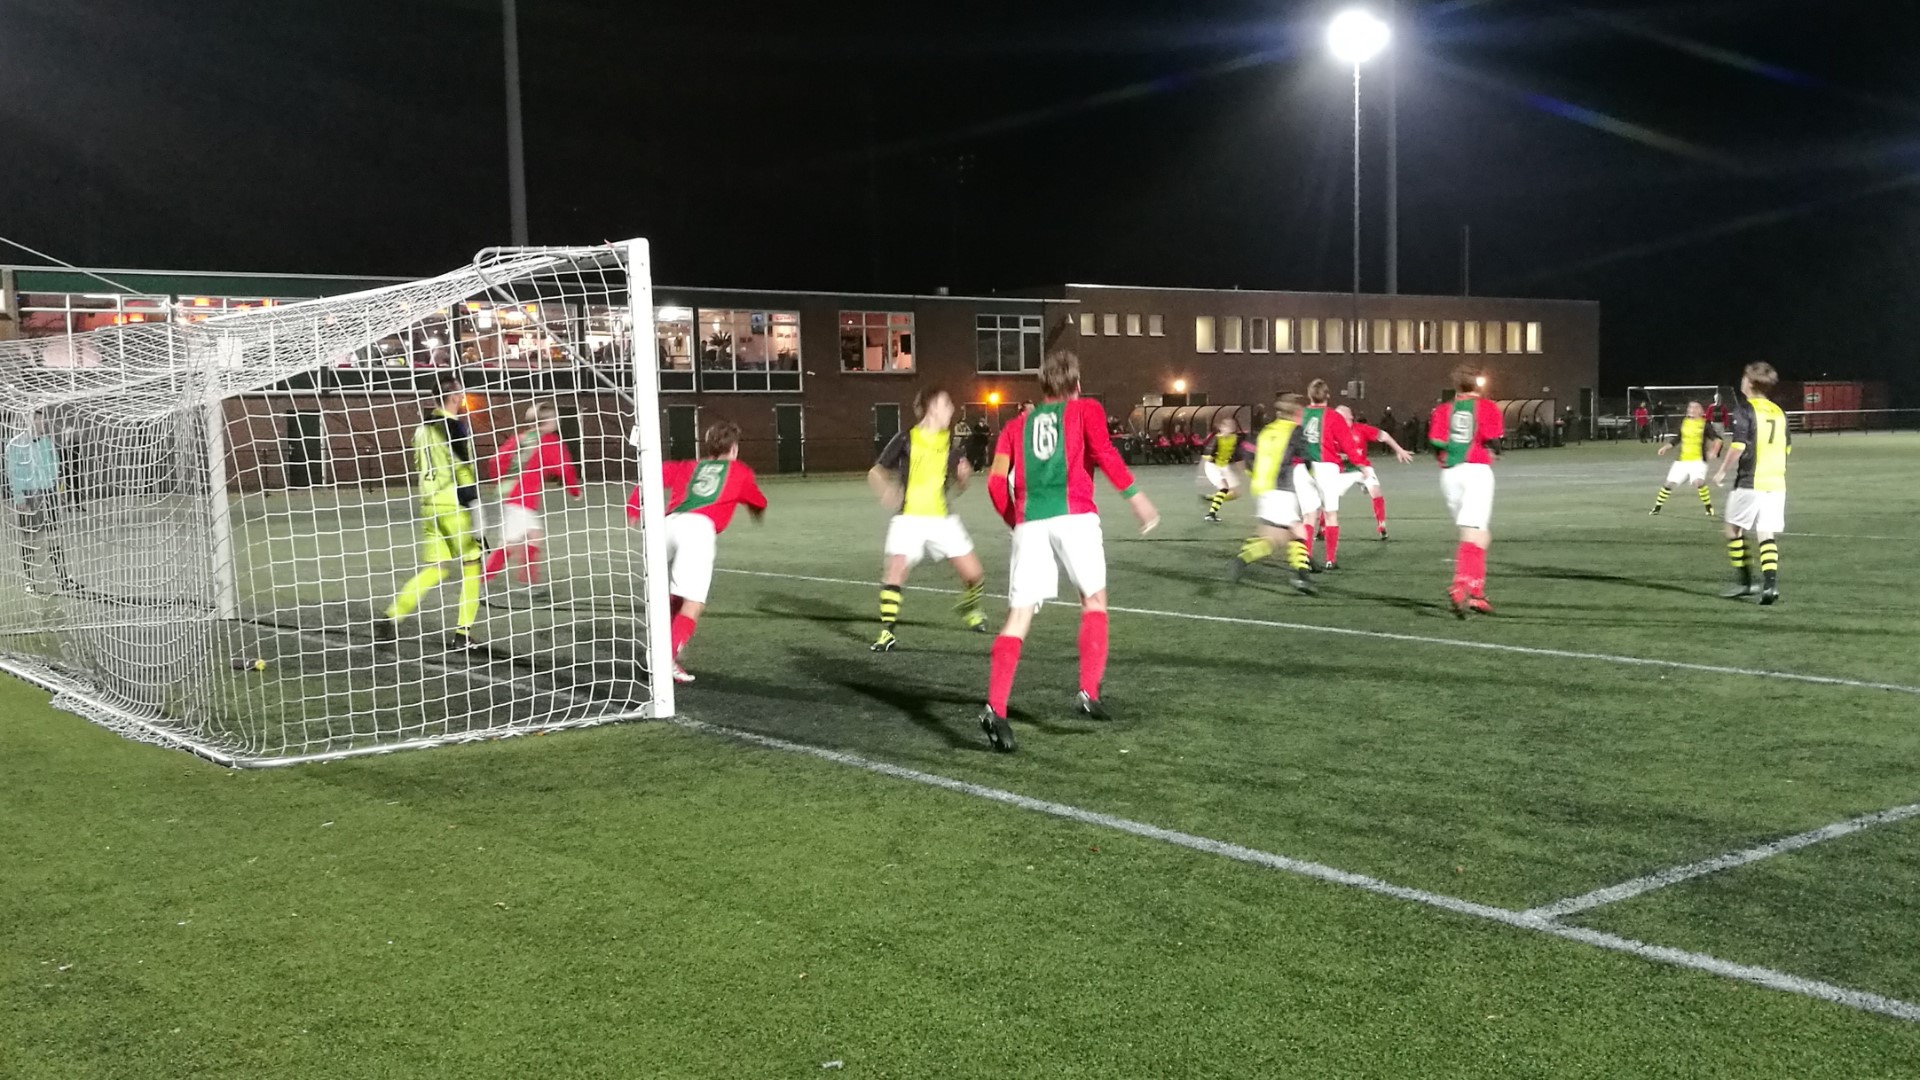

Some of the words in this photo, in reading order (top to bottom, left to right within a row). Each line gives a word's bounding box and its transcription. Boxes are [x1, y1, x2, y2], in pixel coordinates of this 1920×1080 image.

[1033, 412, 1058, 460] 6
[1303, 416, 1320, 443] 4
[1450, 410, 1474, 443] 9
[1766, 419, 1776, 444] 7
[692, 463, 724, 497] 5
